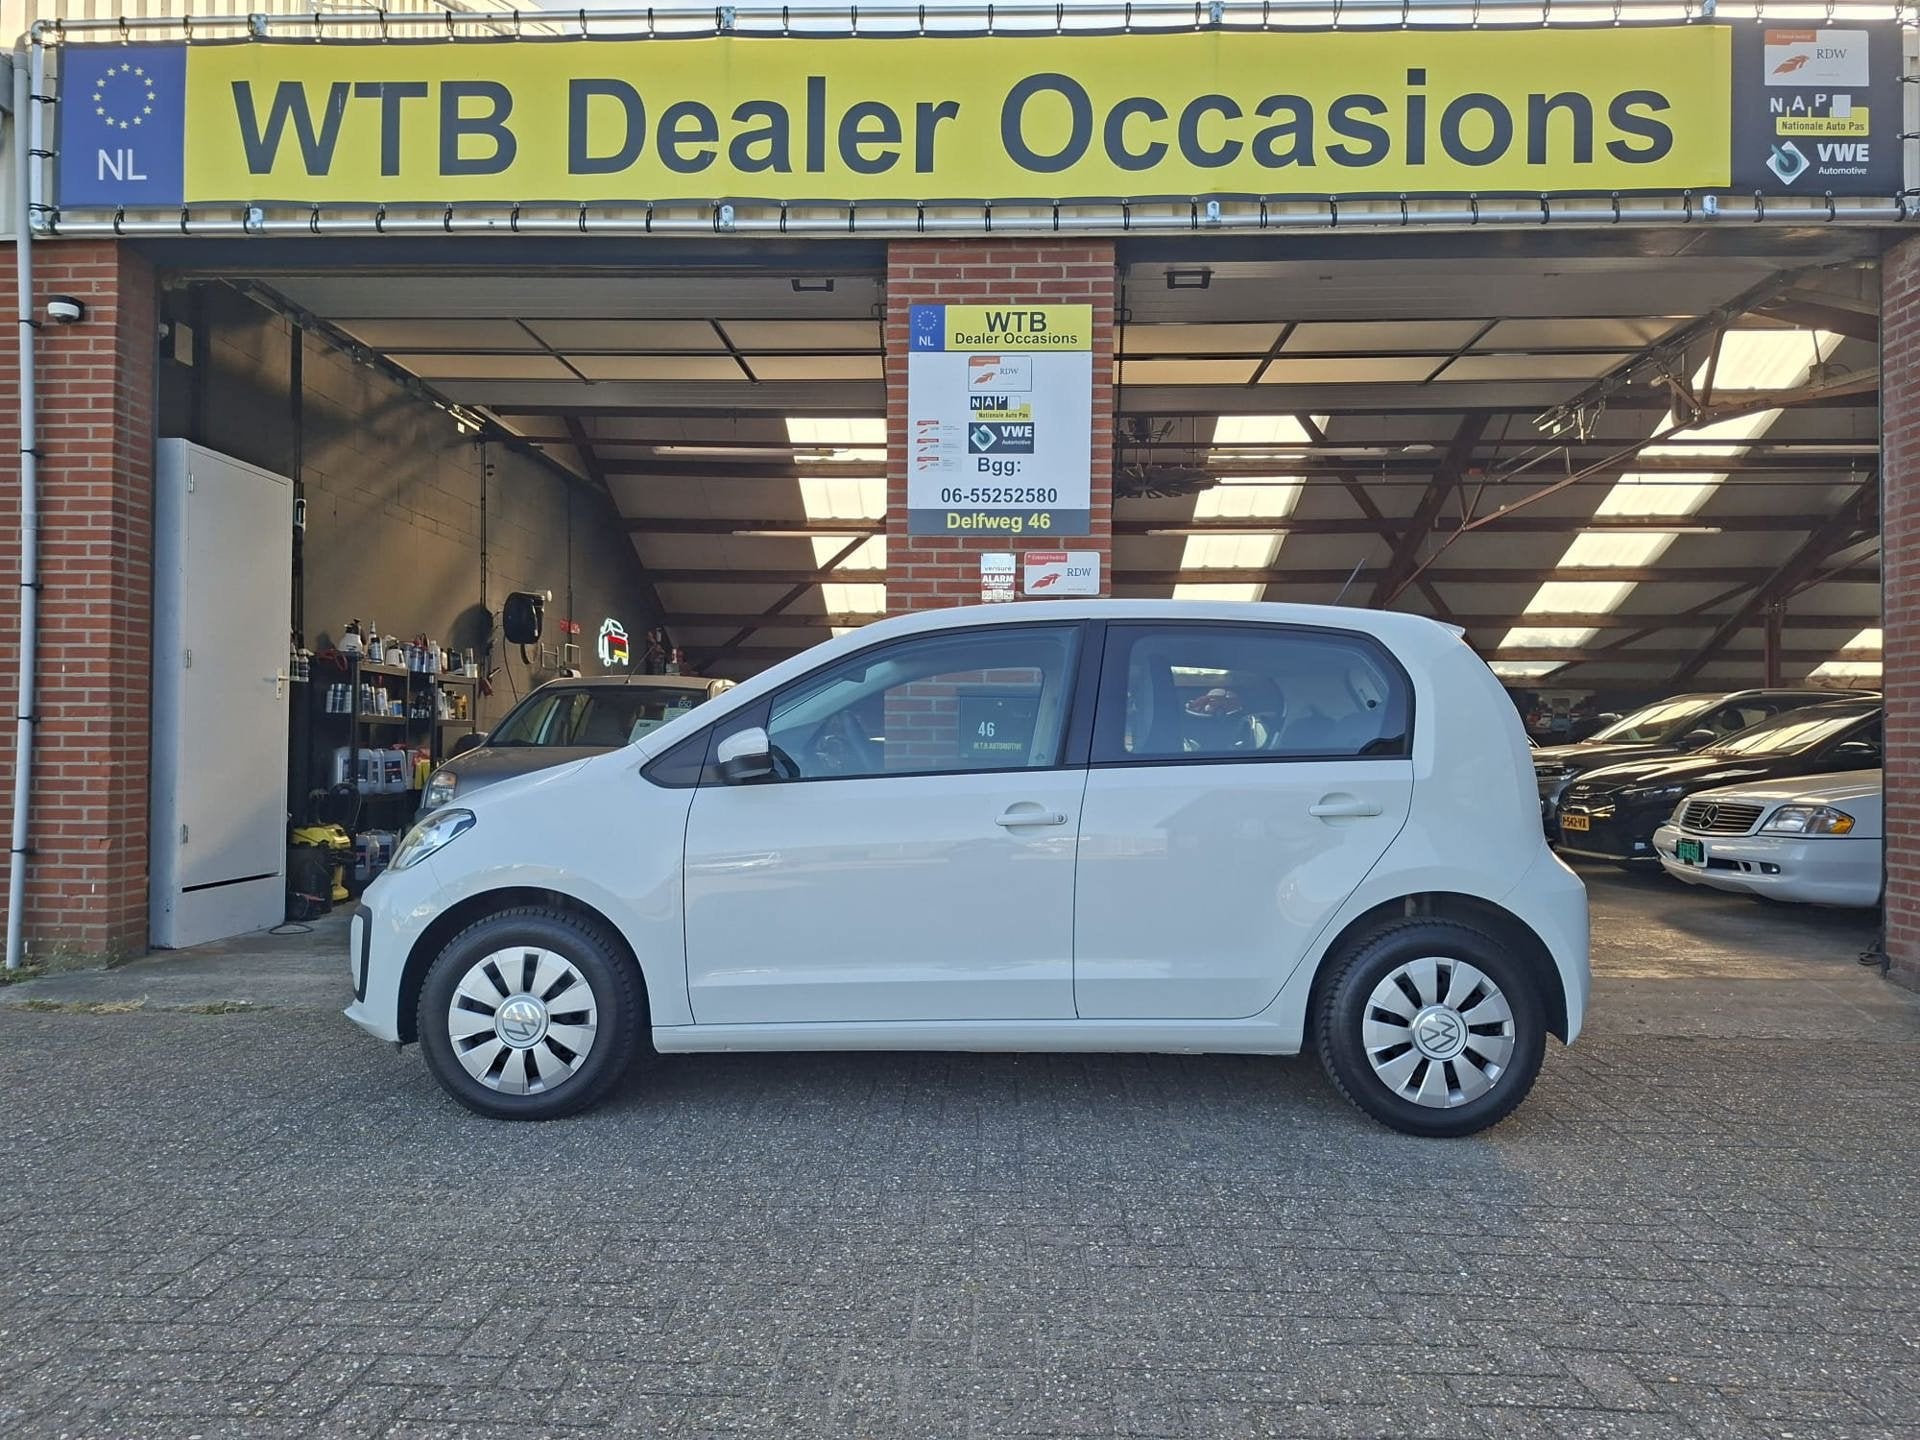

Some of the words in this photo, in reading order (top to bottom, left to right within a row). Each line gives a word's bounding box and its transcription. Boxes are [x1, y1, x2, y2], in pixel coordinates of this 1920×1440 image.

[1816, 48, 1847, 60] RDW
[231, 80, 517, 177] WTB
[567, 75, 960, 176] Dealer
[1000, 67, 1674, 173] Occasions
[1782, 121, 1823, 131] Nationale
[1826, 121, 1846, 131] Auto
[1849, 121, 1865, 131] Pas
[1817, 143, 1870, 162] VWE
[98, 149, 147, 180] NL
[1818, 166, 1868, 175] Automotive
[985, 311, 1047, 333] WTB
[918, 336, 934, 347] NL
[955, 332, 1000, 345] Dealer
[1004, 332, 1078, 345] Occasions
[999, 367, 1019, 376] RDW
[1000, 425, 1032, 438] VWE
[977, 457, 1021, 476] Bgg:
[941, 487, 1058, 503] 06-55252580
[947, 512, 1023, 533] Delfweg
[1028, 513, 1051, 529] 46
[1067, 567, 1092, 577] RDW
[982, 574, 1015, 584] ALARM
[977, 721, 996, 737] 46
